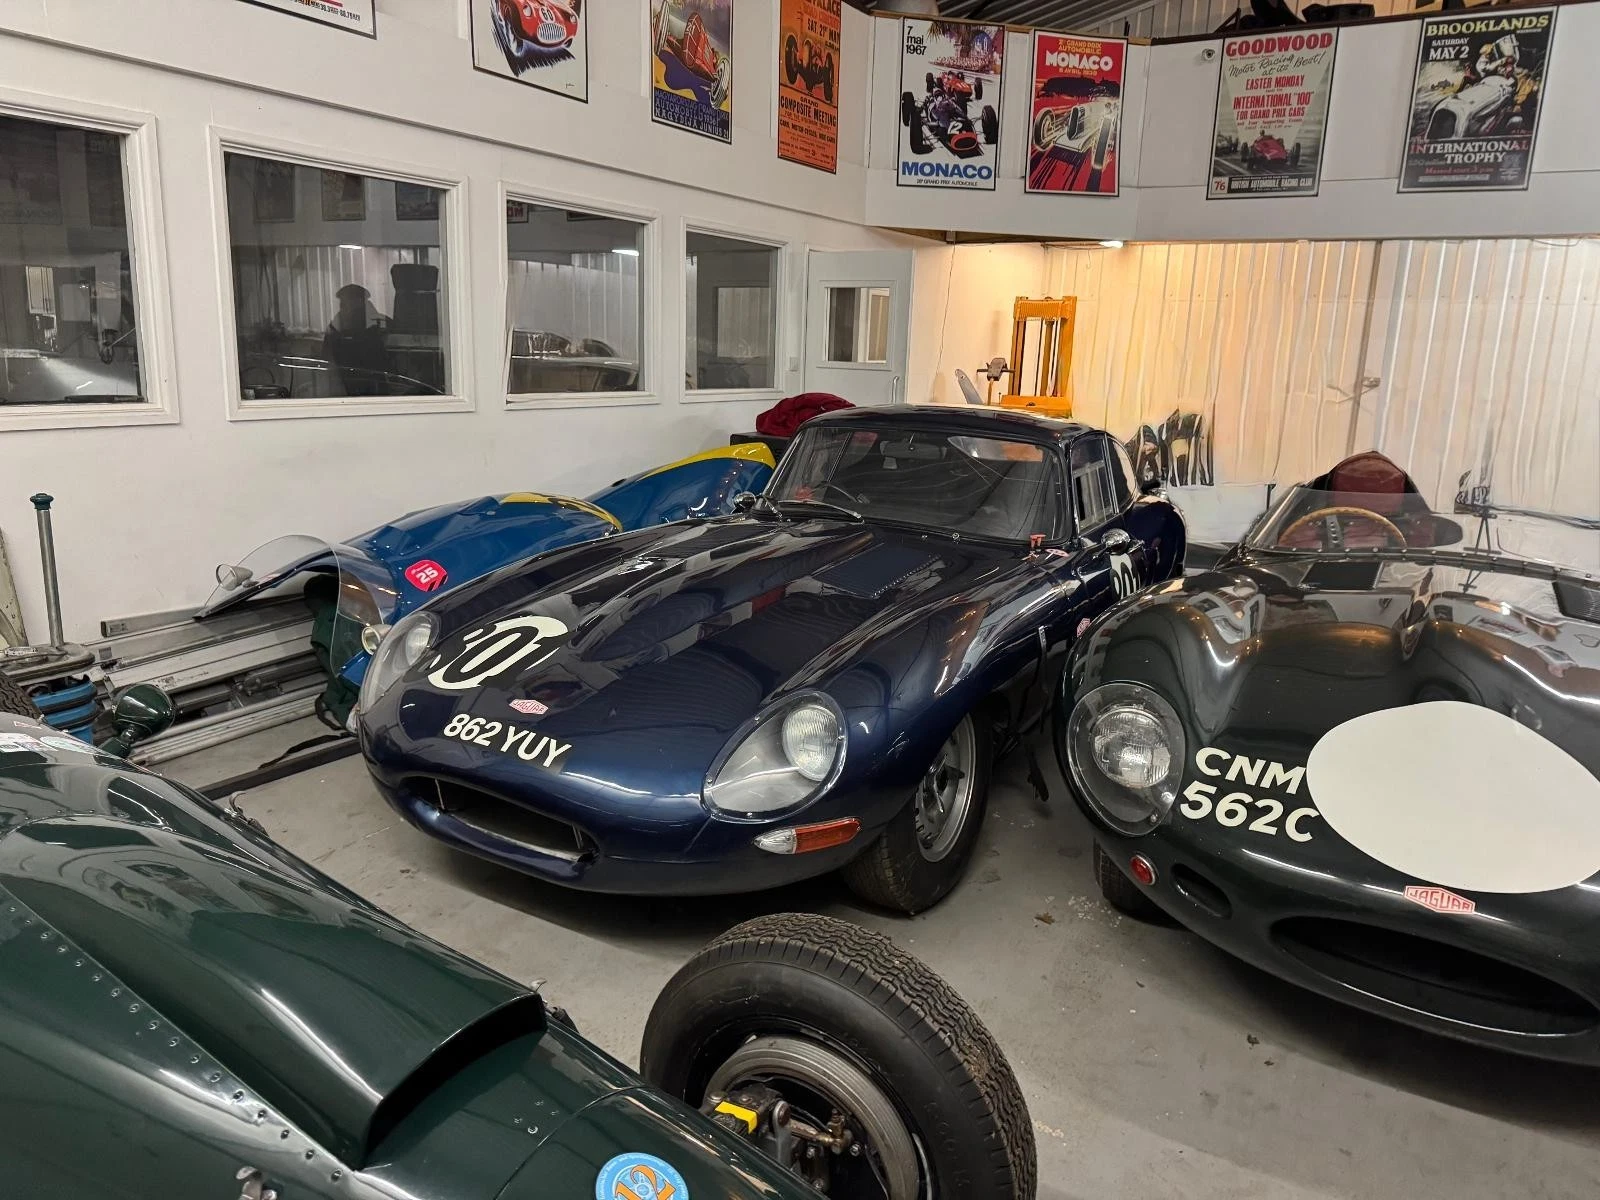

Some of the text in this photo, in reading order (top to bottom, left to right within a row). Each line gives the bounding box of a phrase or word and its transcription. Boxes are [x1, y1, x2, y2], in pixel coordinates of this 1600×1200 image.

[907, 26, 913, 35] 7
[1426, 14, 1550, 37] BROOKLANDS
[906, 34, 924, 45] mai
[1066, 40, 1087, 48] GRAND
[1225, 32, 1333, 57] GOODWOOD
[1431, 37, 1470, 47] SATURDAY
[905, 44, 927, 56] 1967
[1058, 45, 1101, 55] AUTOMOBILE
[1429, 46, 1470, 61] MAY 2
[1045, 50, 1113, 72] MONACO
[1258, 53, 1295, 69] Racing
[1277, 64, 1289, 74] its
[1262, 67, 1274, 77] at
[1246, 77, 1273, 91] EASTER
[1275, 75, 1305, 88] MONDAY
[1233, 93, 1292, 110] INTERNATIONAL
[780, 96, 812, 118] COMPOSITE
[813, 108, 837, 127] MEETING
[1236, 106, 1305, 121] FOR GRAND PRIX CARS
[947, 120, 962, 134] 12
[1410, 139, 1529, 155] INTERNATIONAL
[1445, 152, 1507, 165] TROPHY
[901, 161, 993, 180] MONACO
[415, 566, 439, 584] 25
[443, 713, 572, 768] 862 YUY
[1195, 746, 1307, 795] CNM
[1180, 780, 1320, 842] 562C
[1408, 888, 1472, 912] JAGUAR
